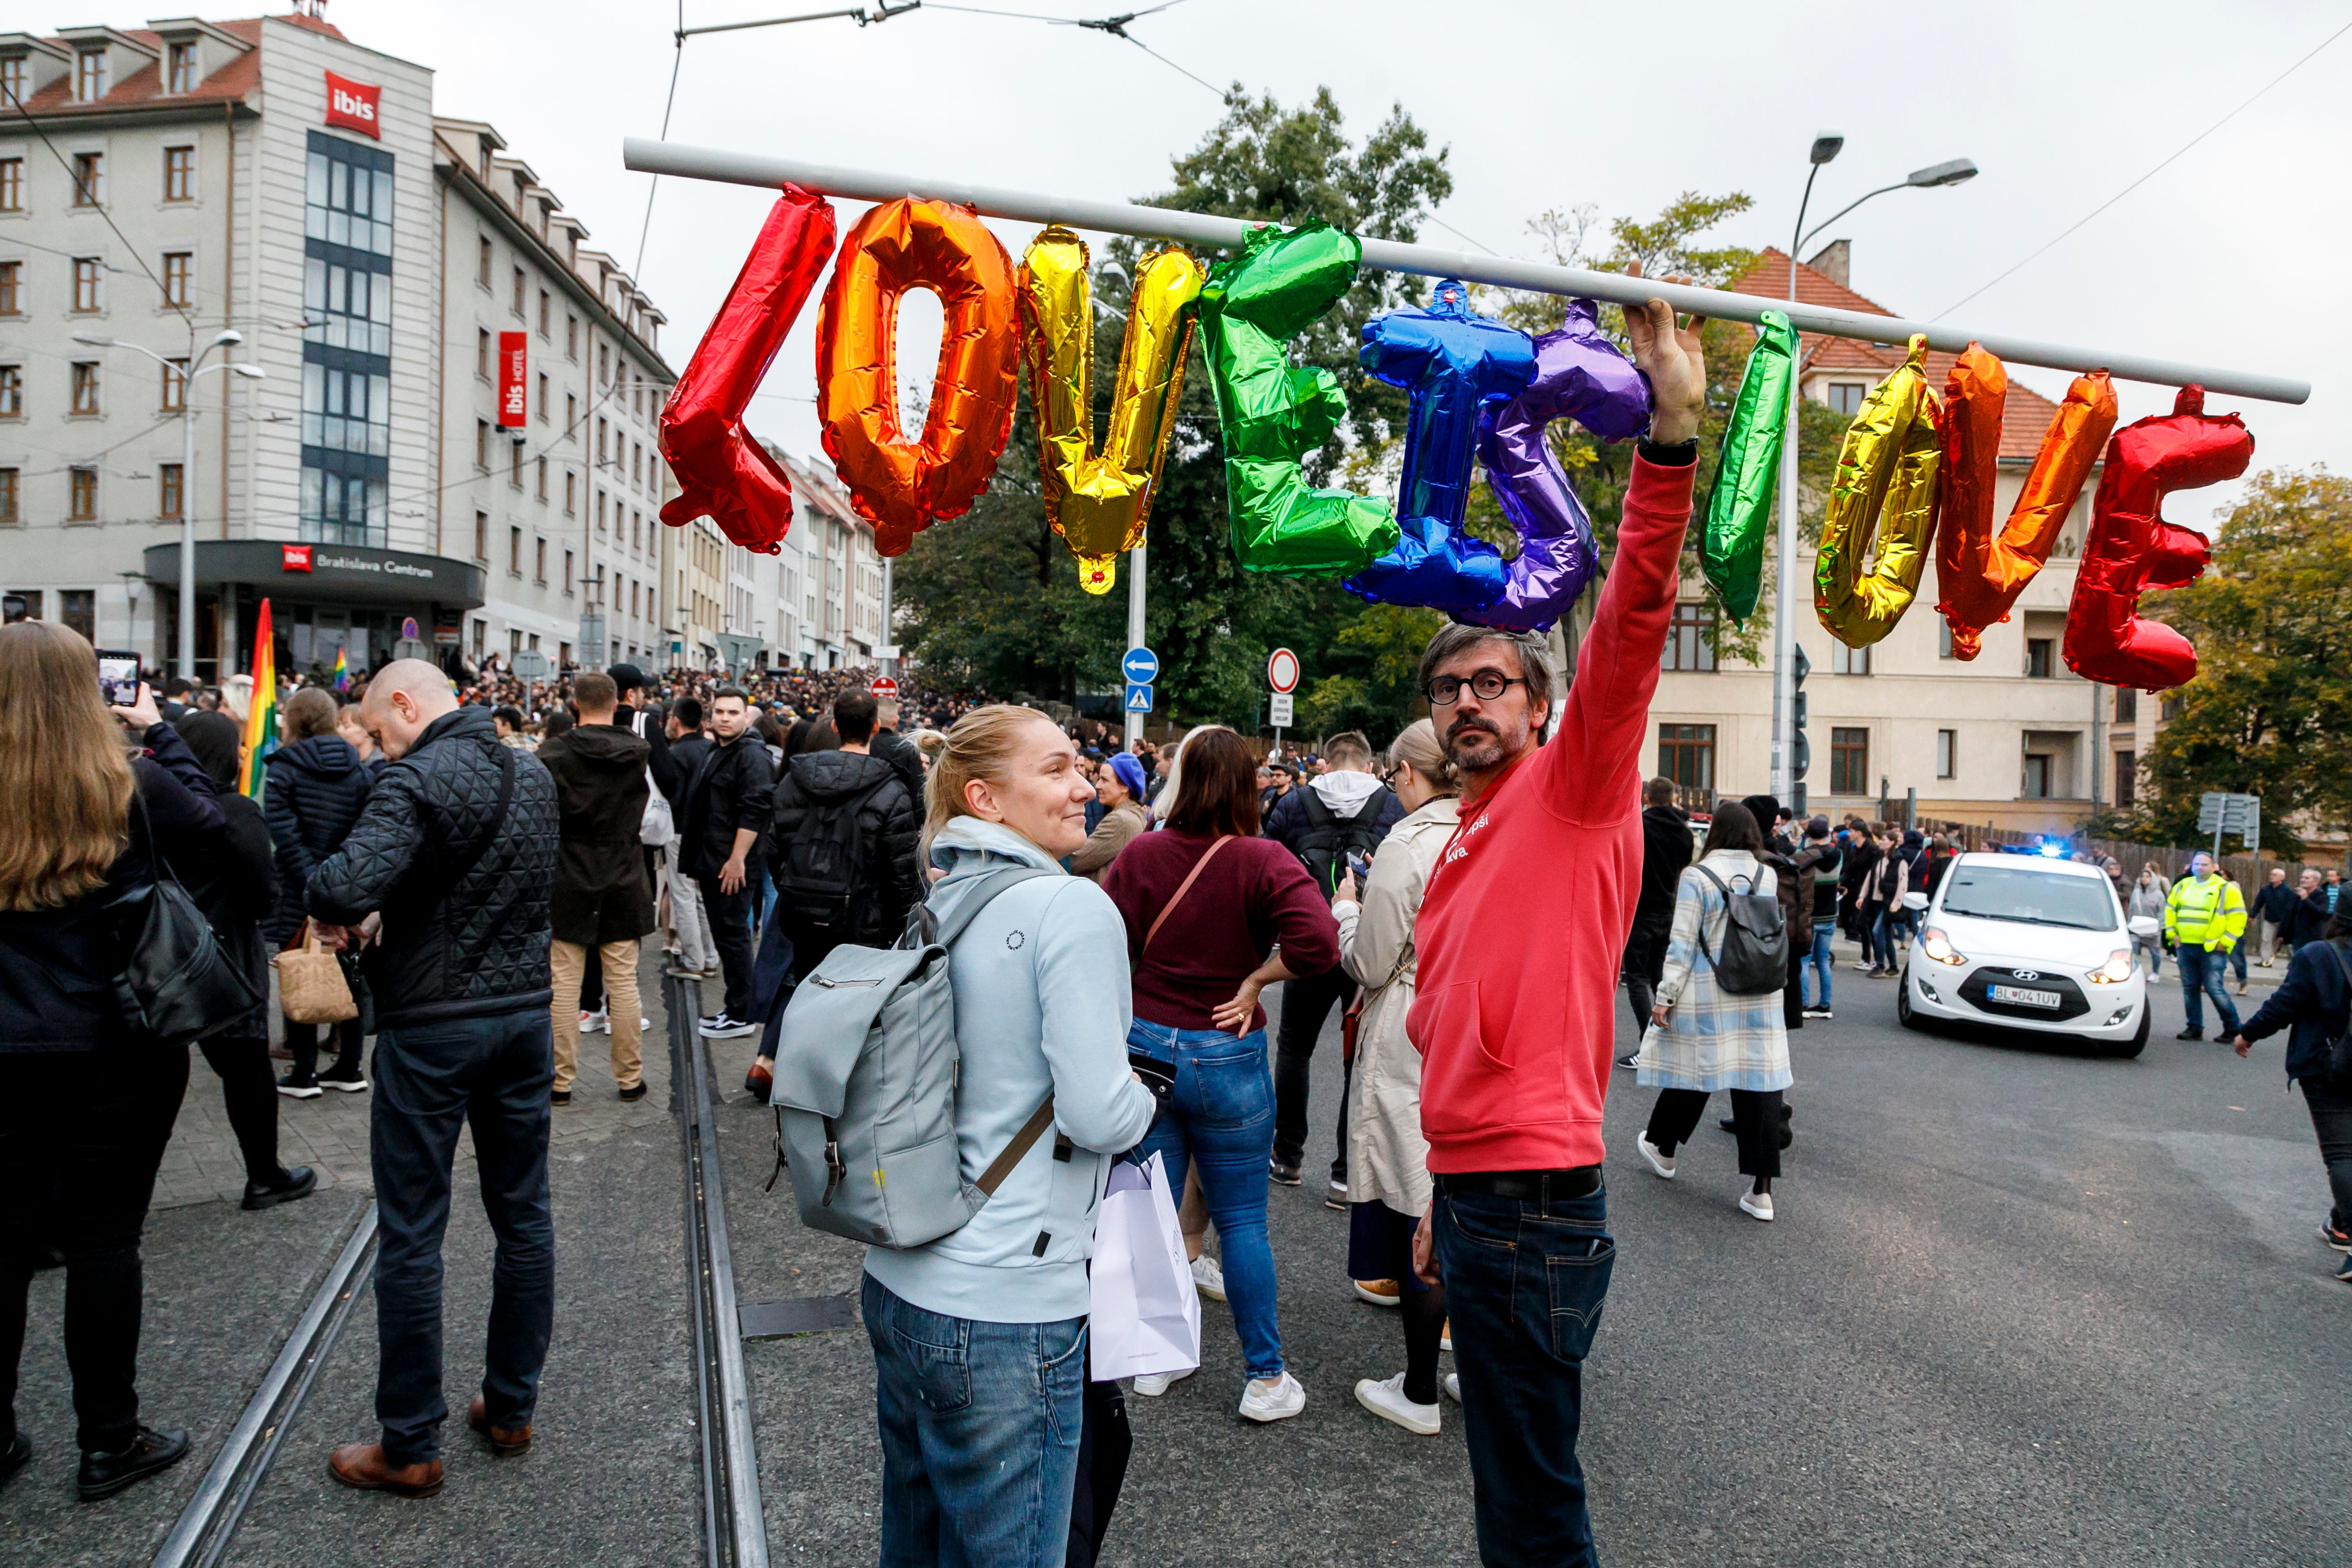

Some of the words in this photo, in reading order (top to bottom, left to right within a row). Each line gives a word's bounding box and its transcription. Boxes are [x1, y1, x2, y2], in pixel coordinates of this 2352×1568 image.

[333, 88, 374, 121] ibis
[506, 385, 523, 414] ibis
[658, 181, 1402, 595] LOVE
[285, 552, 307, 564] ibis
[317, 554, 380, 572] Bratislava
[384, 560, 433, 578] Centrum
